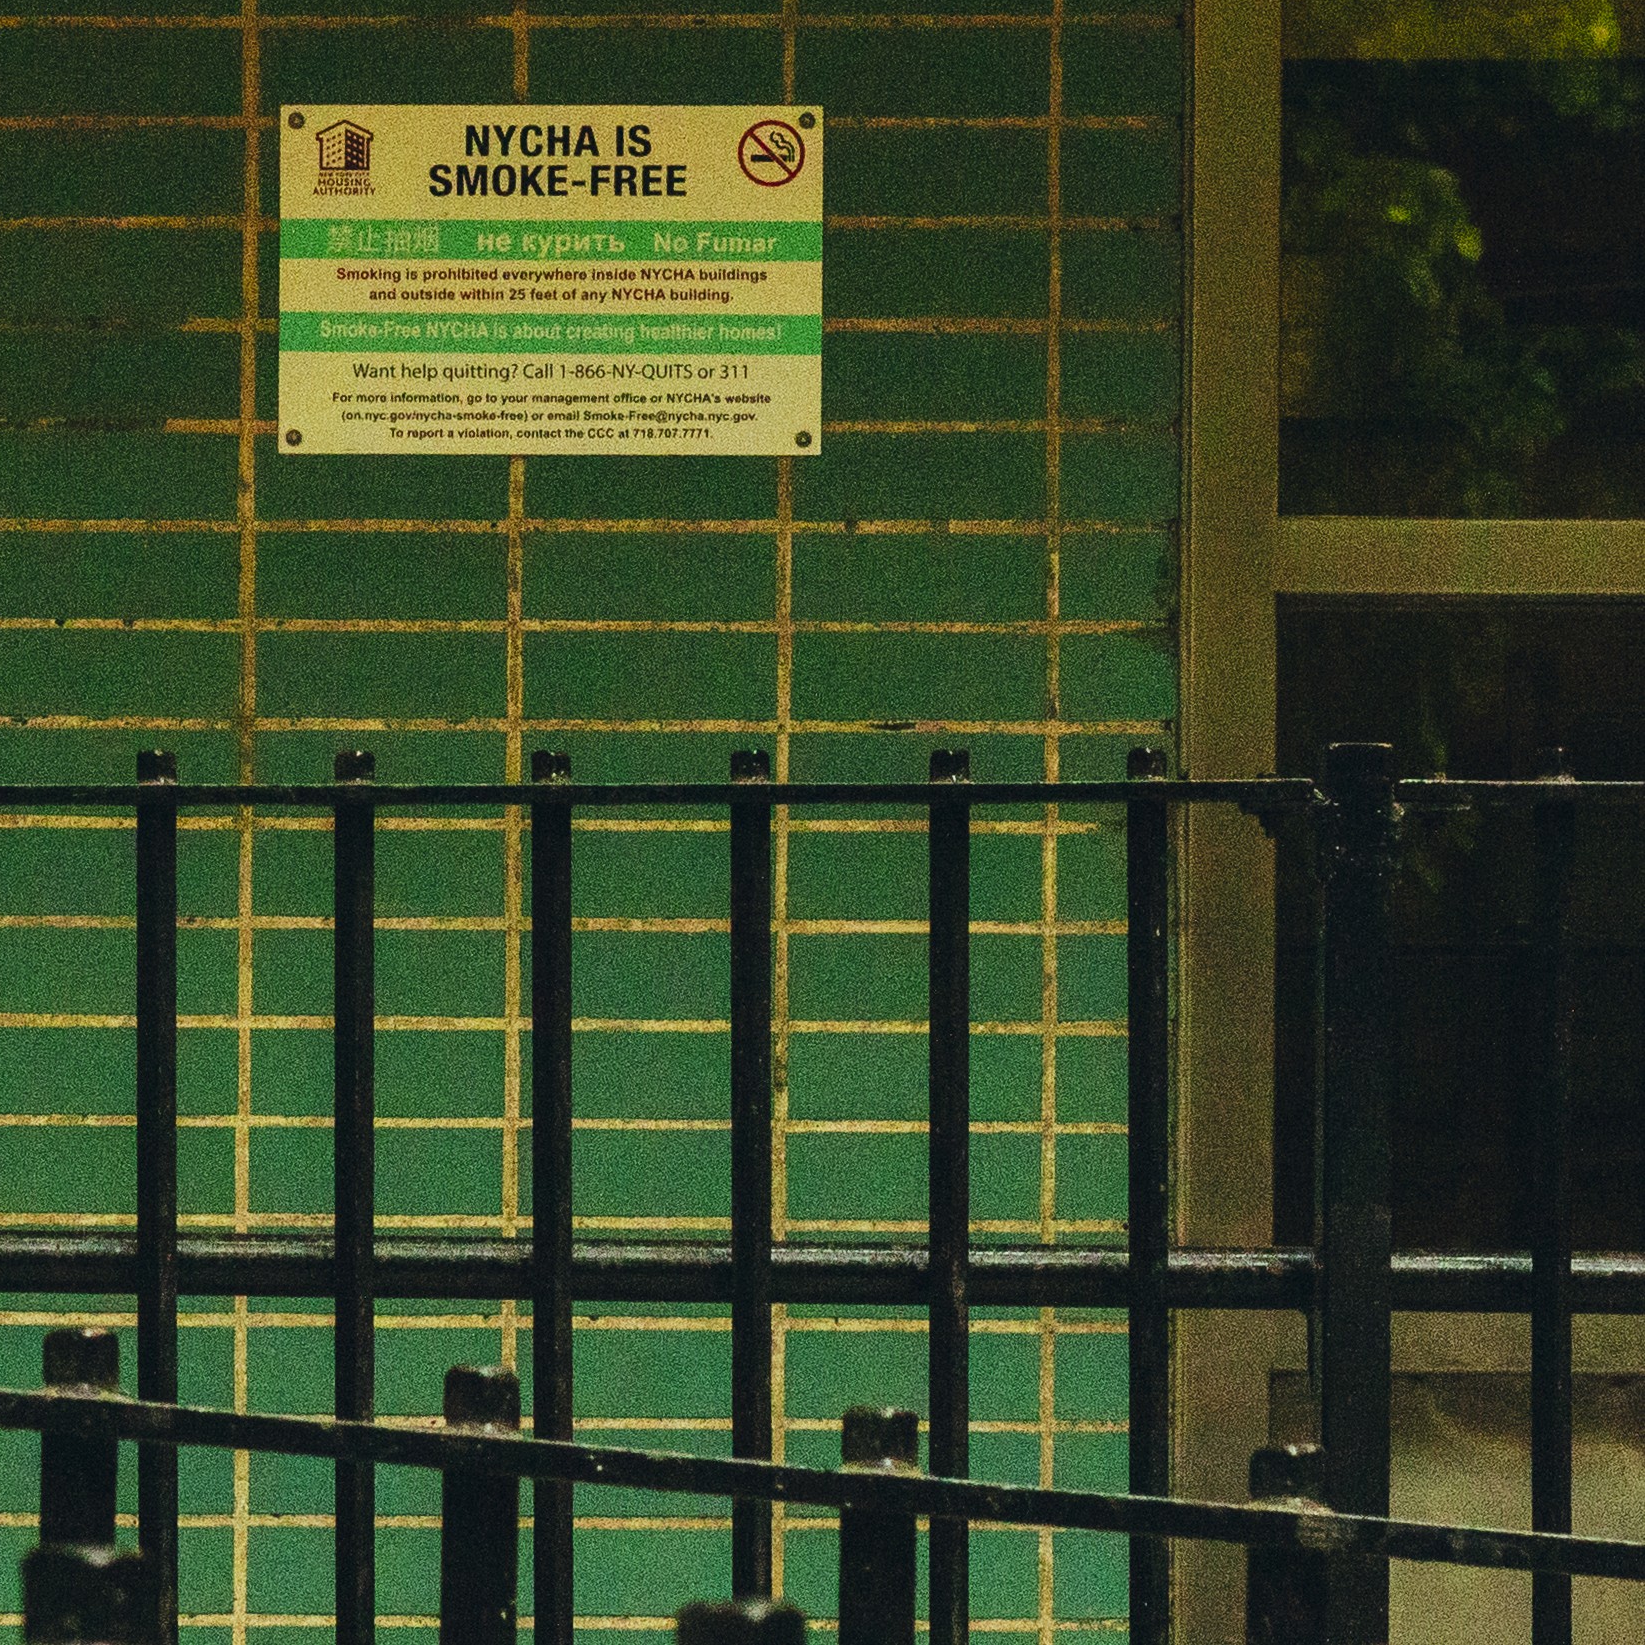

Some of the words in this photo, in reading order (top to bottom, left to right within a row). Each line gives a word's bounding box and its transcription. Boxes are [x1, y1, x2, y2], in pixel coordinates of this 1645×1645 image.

[465, 125, 600, 157] NYCHA
[616, 124, 652, 158] IS
[318, 178, 371, 186] HOUSING
[429, 164, 687, 197] SMOKE-FREE
[313, 187, 376, 196] AUTHORITY
[654, 233, 688, 253] No
[697, 233, 778, 253] Fumar
[336, 268, 401, 283] Smoking
[406, 268, 418, 280] is
[423, 268, 498, 283] prohibited
[502, 269, 587, 284] everywhere
[592, 268, 636, 281] inside
[641, 269, 695, 281] NYCHA
[699, 268, 768, 284] buildings
[369, 288, 396, 301] and
[401, 288, 455, 301] outside
[460, 288, 504, 301] within
[509, 289, 526, 301] 25
[530, 289, 557, 301] feet
[562, 289, 577, 301] of
[581, 292, 607, 304] any
[612, 289, 666, 301] NYCHA
[670, 289, 734, 304] building.
[320, 321, 421, 338] Smoke-Free
[426, 322, 488, 339] NYCHA
[493, 322, 507, 339] is
[513, 322, 560, 339] about
[566, 324, 635, 343] creating
[640, 324, 712, 340] healthier
[719, 324, 782, 340] homes!
[353, 364, 395, 379] Want
[401, 364, 438, 382] help
[443, 364, 518, 382] quitting?
[523, 364, 554, 379] Call
[560, 364, 692, 380] 1-866-NY-QUITS
[697, 368, 715, 379] or
[720, 364, 749, 379] 311
[332, 393, 352, 403] For
[356, 395, 387, 403] more
[391, 393, 464, 405] information,
[467, 395, 482, 406] go
[486, 393, 497, 403] to
[502, 396, 528, 406] your
[532, 394, 609, 406] management
[613, 393, 647, 403] office
[666, 393, 721, 403] NYCHA's
[725, 393, 771, 403] website
[532, 413, 545, 421] or
[547, 411, 580, 421] email
[390, 428, 404, 439] To
[407, 429, 444, 440] report
[458, 428, 513, 440] violation,
[516, 429, 561, 439] contact
[565, 428, 584, 439] the
[587, 429, 614, 439] CCC
[618, 429, 630, 439] at
